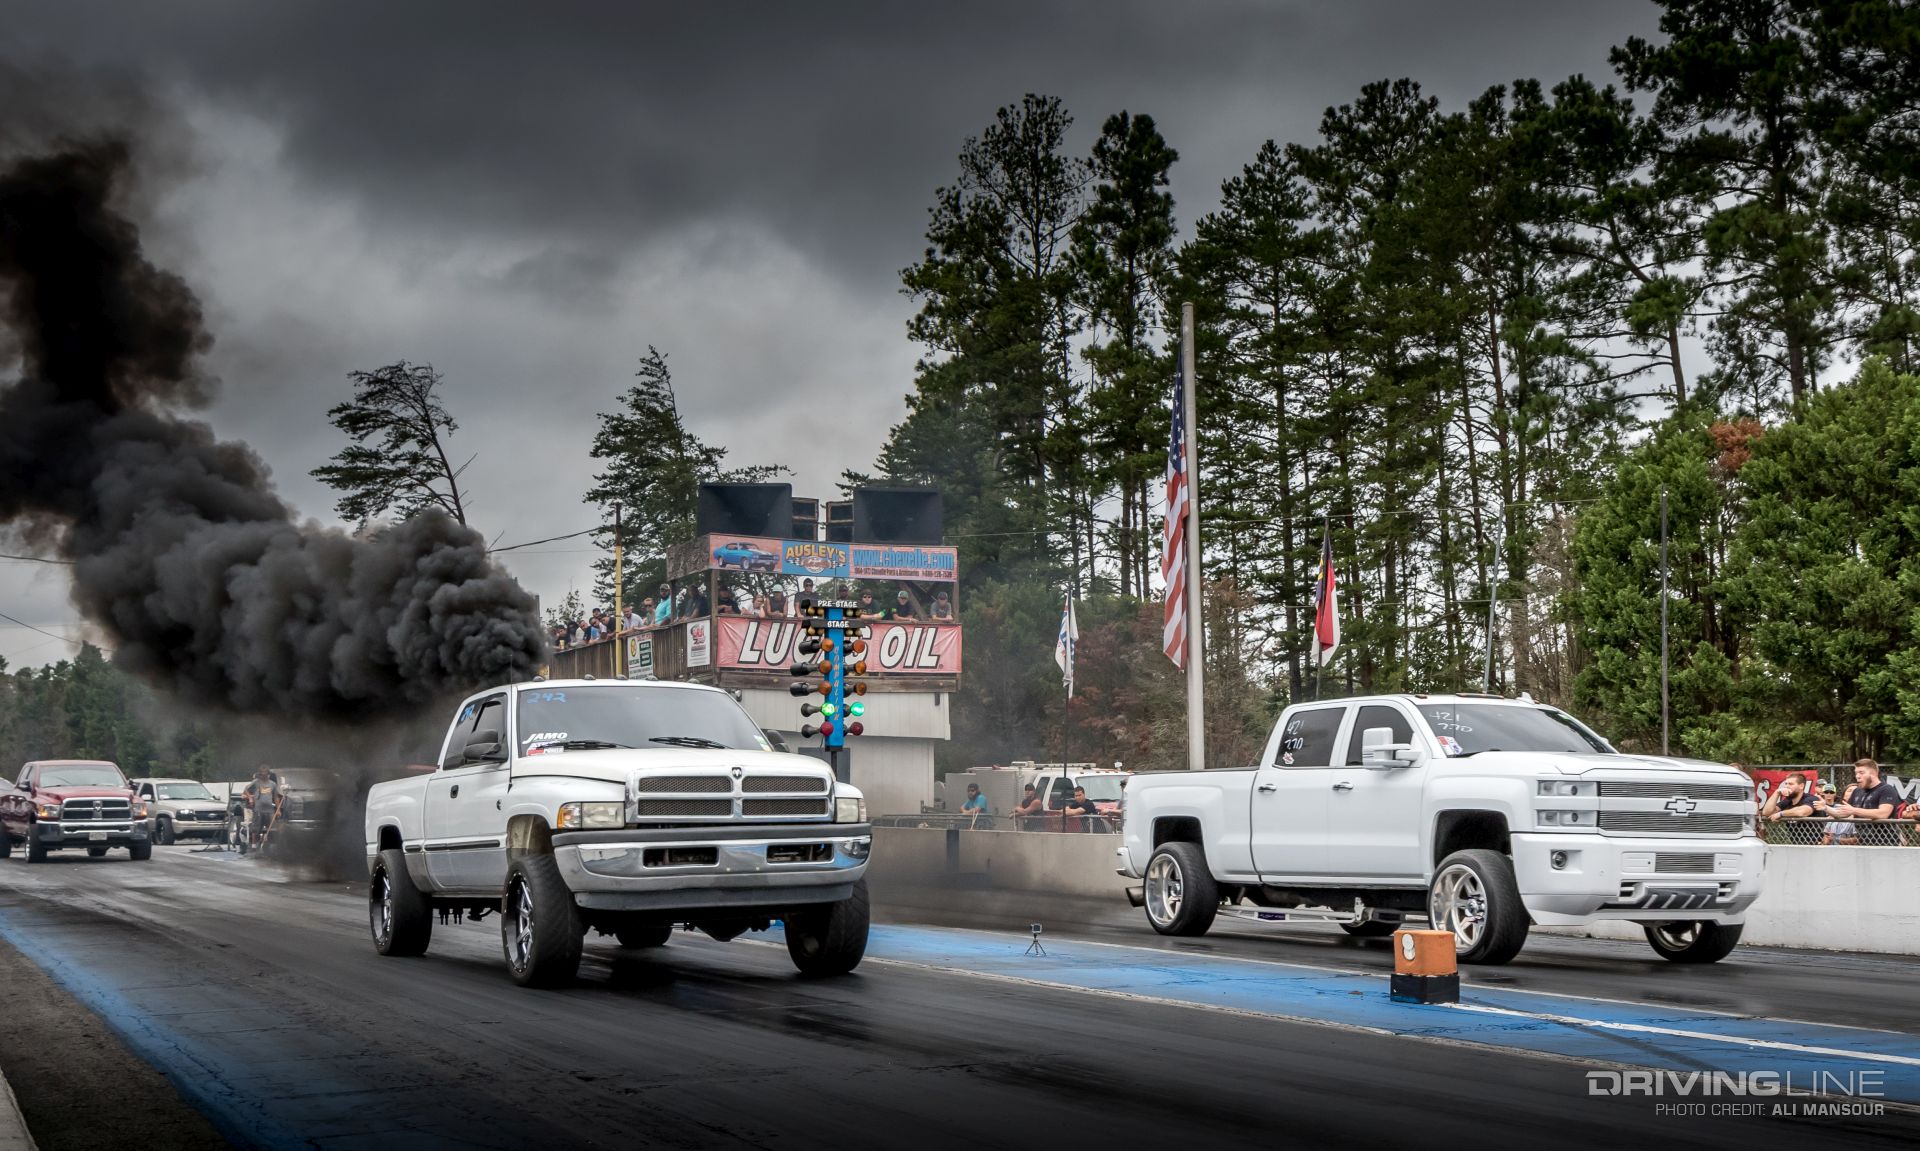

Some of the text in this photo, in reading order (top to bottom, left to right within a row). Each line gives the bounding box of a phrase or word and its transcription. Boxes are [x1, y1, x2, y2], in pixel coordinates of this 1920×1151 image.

[786, 543, 846, 563] AUSLEY'S
[853, 548, 954, 570] www.chevelle.com
[817, 600, 858, 608] PRE-STAGE
[827, 620, 849, 628] STAGE
[880, 625, 940, 669] OIL
[527, 692, 566, 704] 242
[1429, 711, 1460, 721] 421
[522, 732, 568, 744] JAMO
